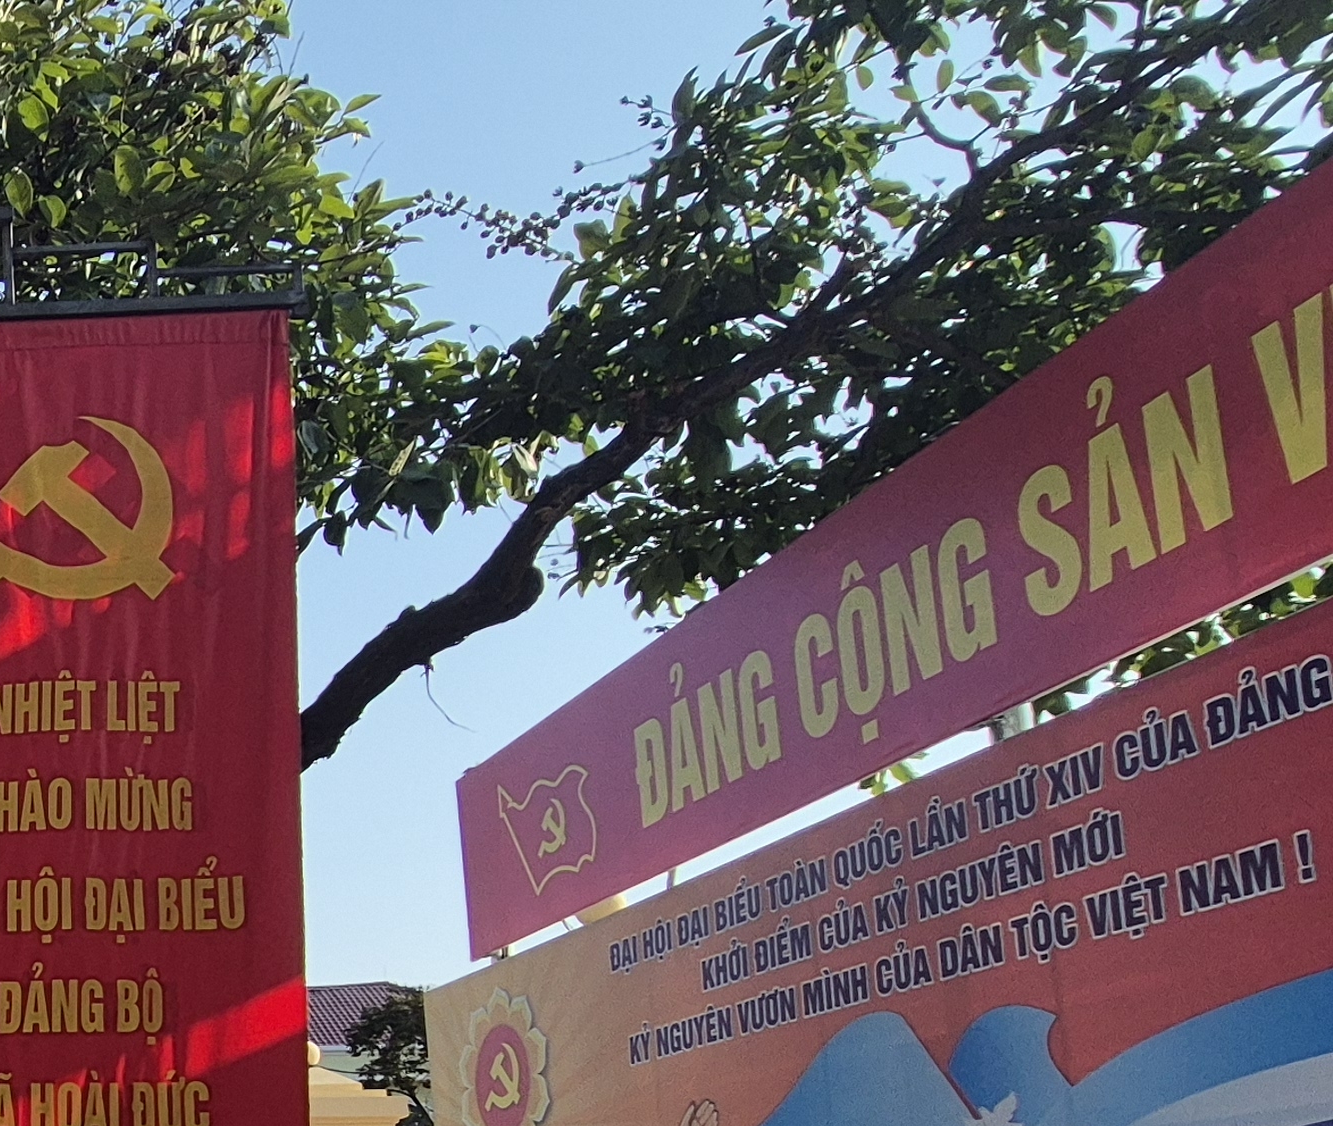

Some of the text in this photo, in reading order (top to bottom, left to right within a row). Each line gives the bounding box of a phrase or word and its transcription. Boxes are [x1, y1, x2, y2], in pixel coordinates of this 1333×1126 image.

[635, 649, 783, 829] ĐẢNG
[793, 517, 998, 745] CỘNG
[1017, 364, 1233, 618] SẢN
[107, 671, 180, 744] LIỆT
[85, 766, 193, 832] MỪNG
[609, 654, 1333, 976] ĐẠI HỘI ĐẠI BIỂU TOÀN QUỐC LẦN THỨ XIV CỦA ĐẢNG
[7, 866, 73, 944] HỘI
[84, 876, 144, 944] ĐẠI
[159, 856, 245, 931] BIỂU
[628, 829, 1317, 1066] KỶ NGUYÊN VƯƠN MÌNH CỦA DÂN TỘC VIỆT NAM !
[700, 807, 1126, 993] KHỞI ĐIỂM CỦA KỶ NGUYÊN MỚI
[117, 968, 164, 1045] BỘ
